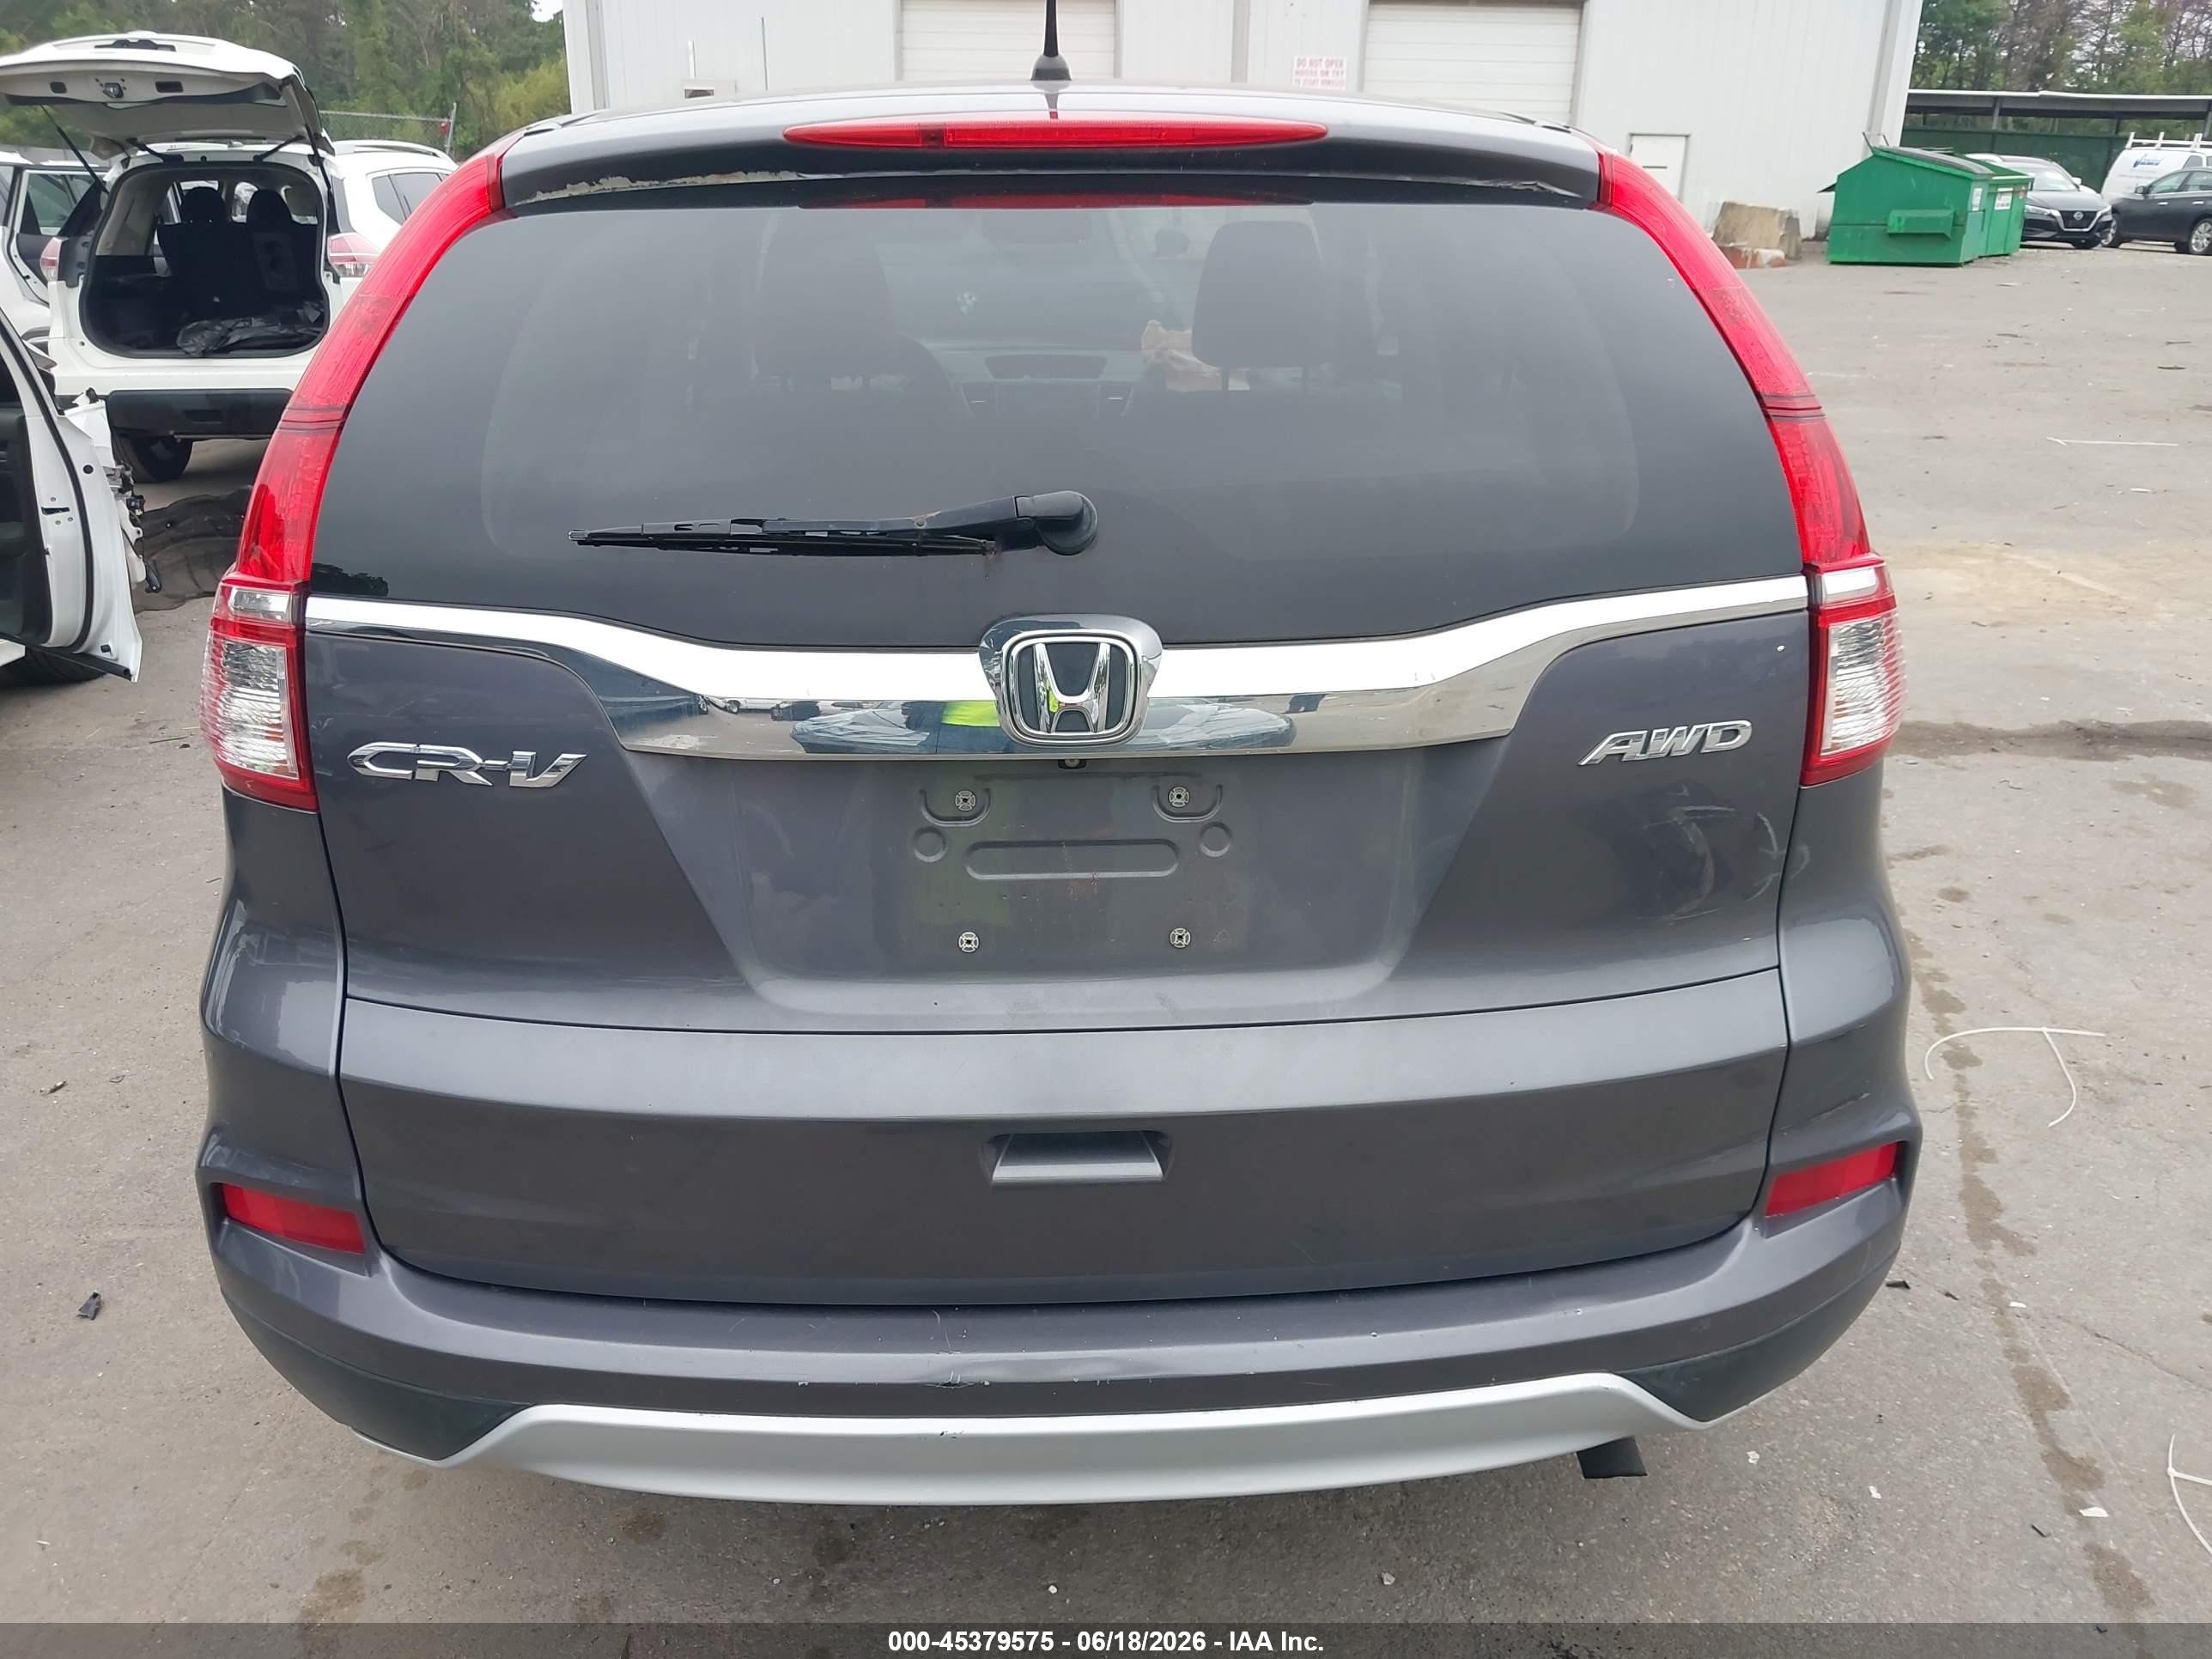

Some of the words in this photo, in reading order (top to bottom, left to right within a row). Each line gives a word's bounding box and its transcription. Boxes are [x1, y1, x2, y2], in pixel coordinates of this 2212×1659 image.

[1297, 58, 1307, 69] DO
[1310, 58, 1322, 69] NOT
[347, 742, 587, 787] CR-V
[1577, 720, 1753, 766] AWD
